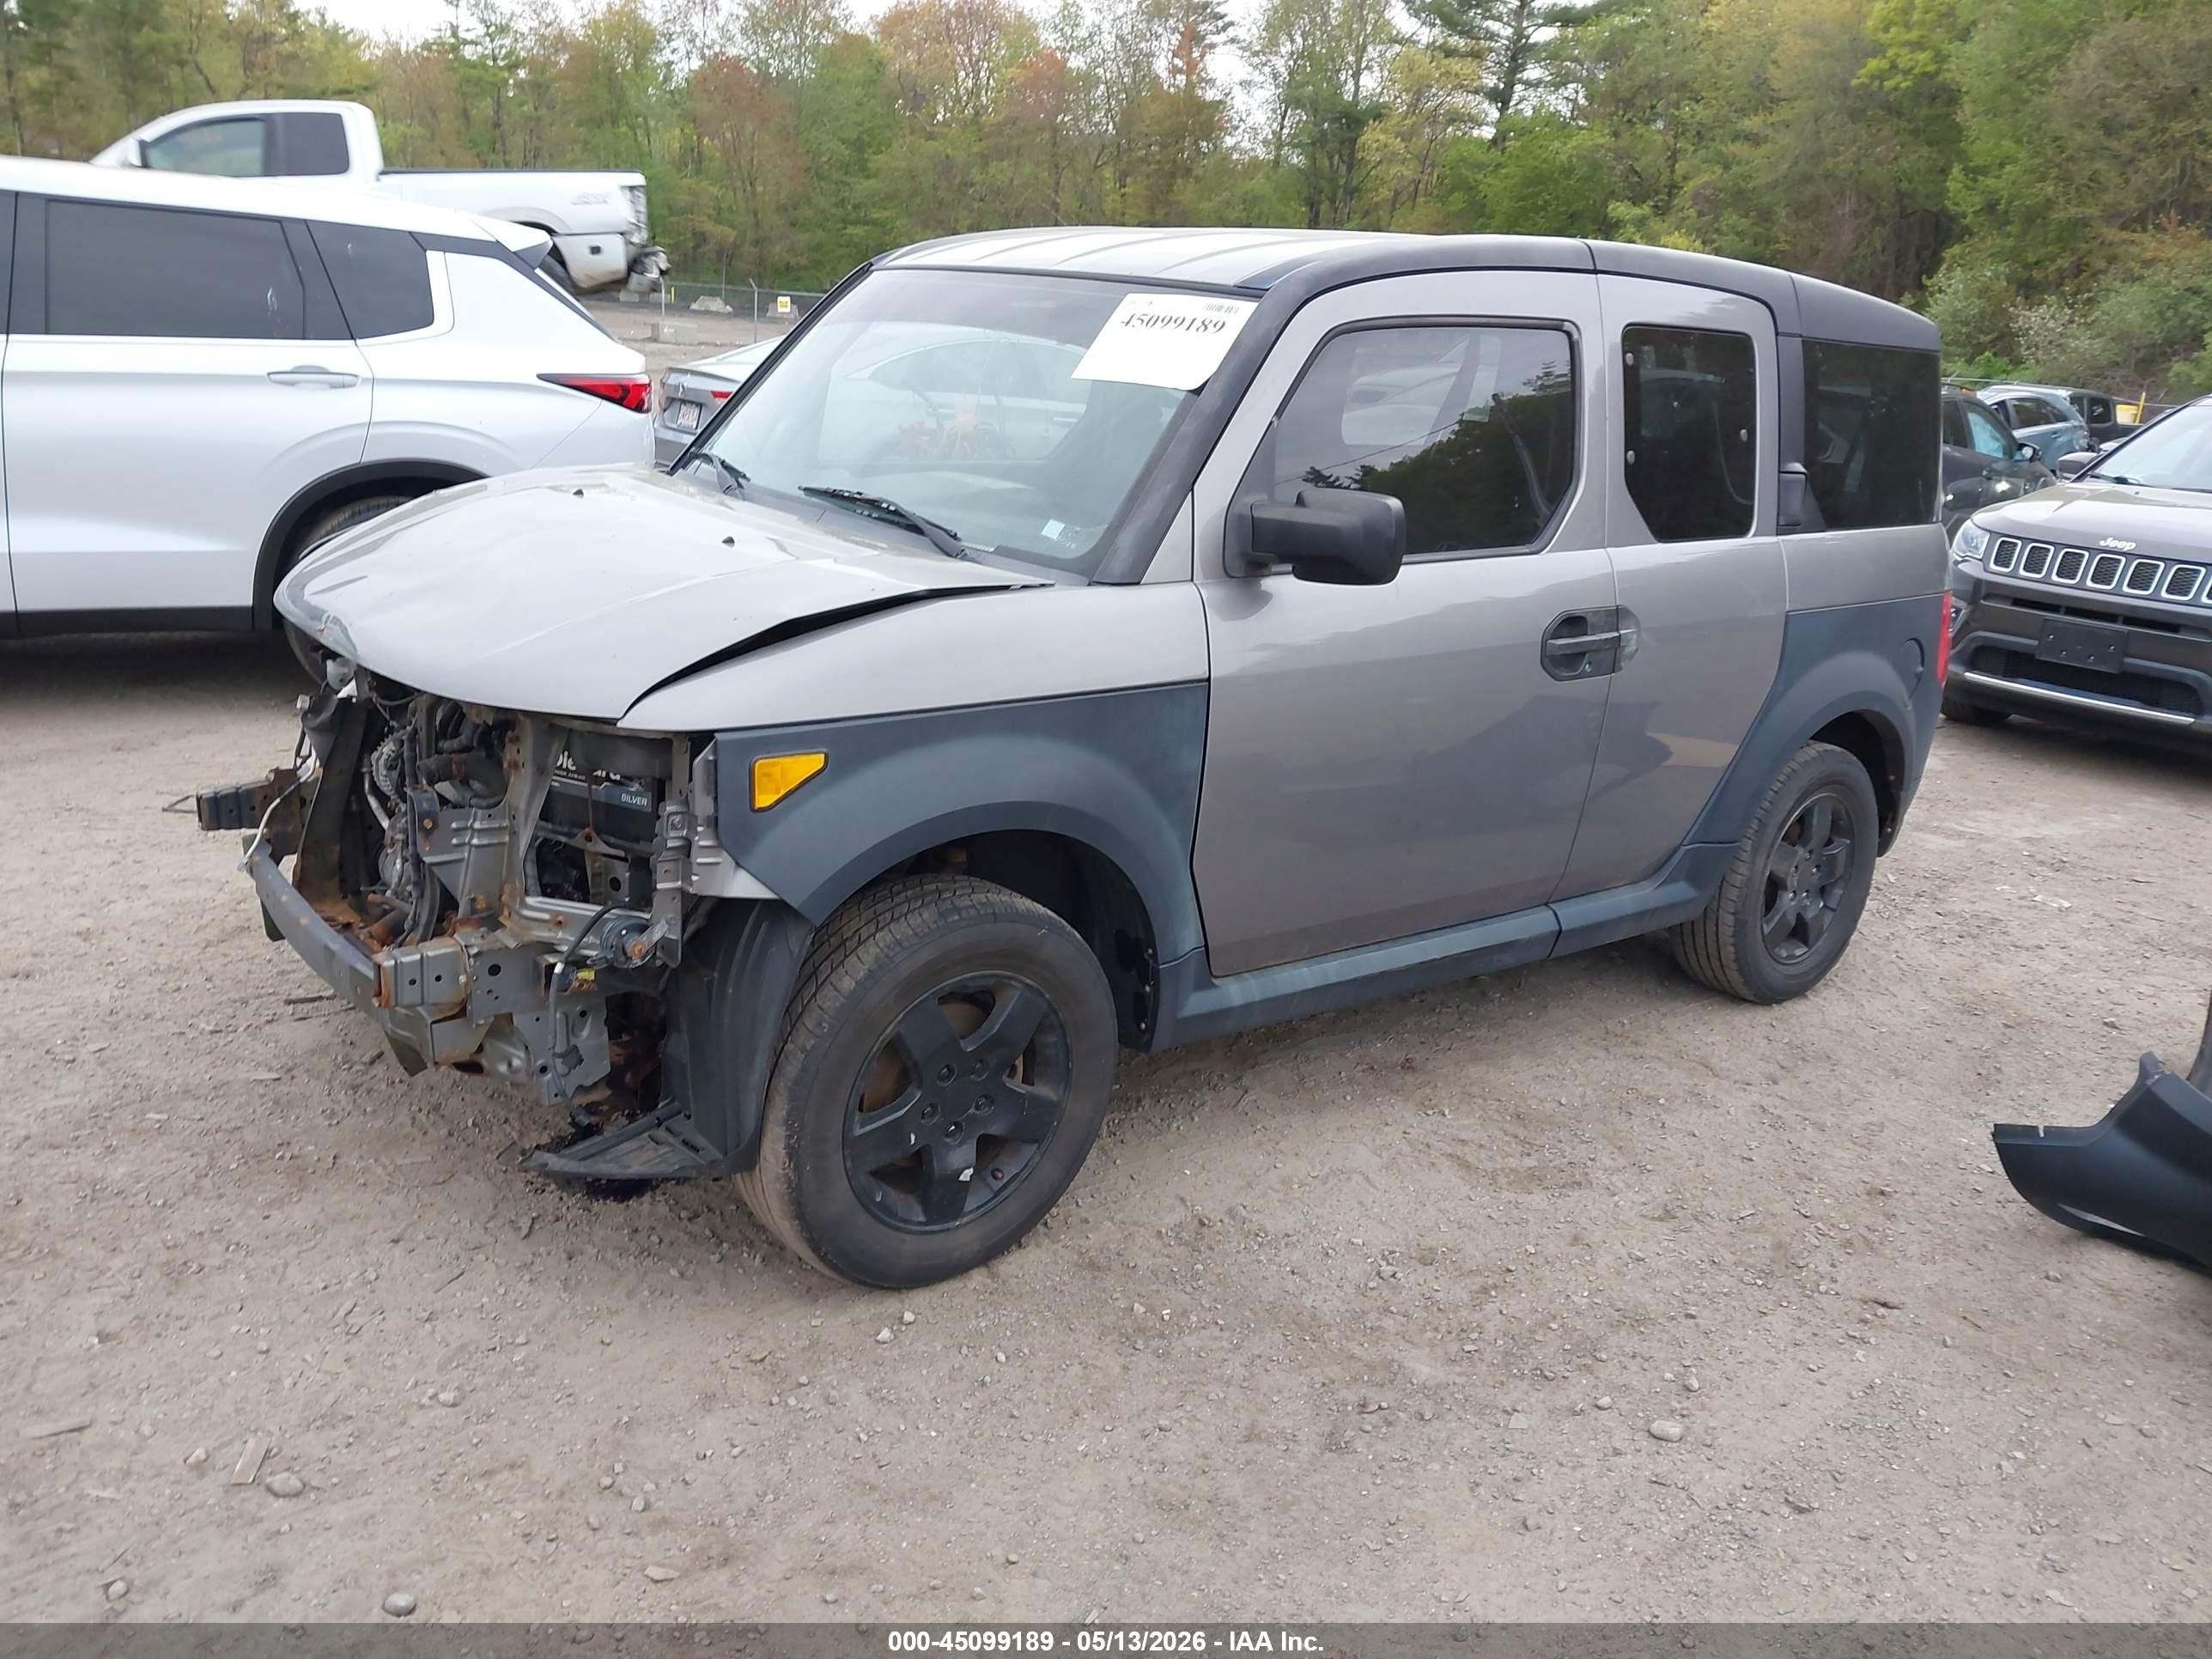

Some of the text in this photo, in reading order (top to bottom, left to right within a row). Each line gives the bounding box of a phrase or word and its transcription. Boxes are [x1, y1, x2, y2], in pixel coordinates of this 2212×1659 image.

[1121, 313, 1226, 333] 45099189
[2099, 537, 2136, 551] Jeep
[621, 793, 647, 806] SILVER
